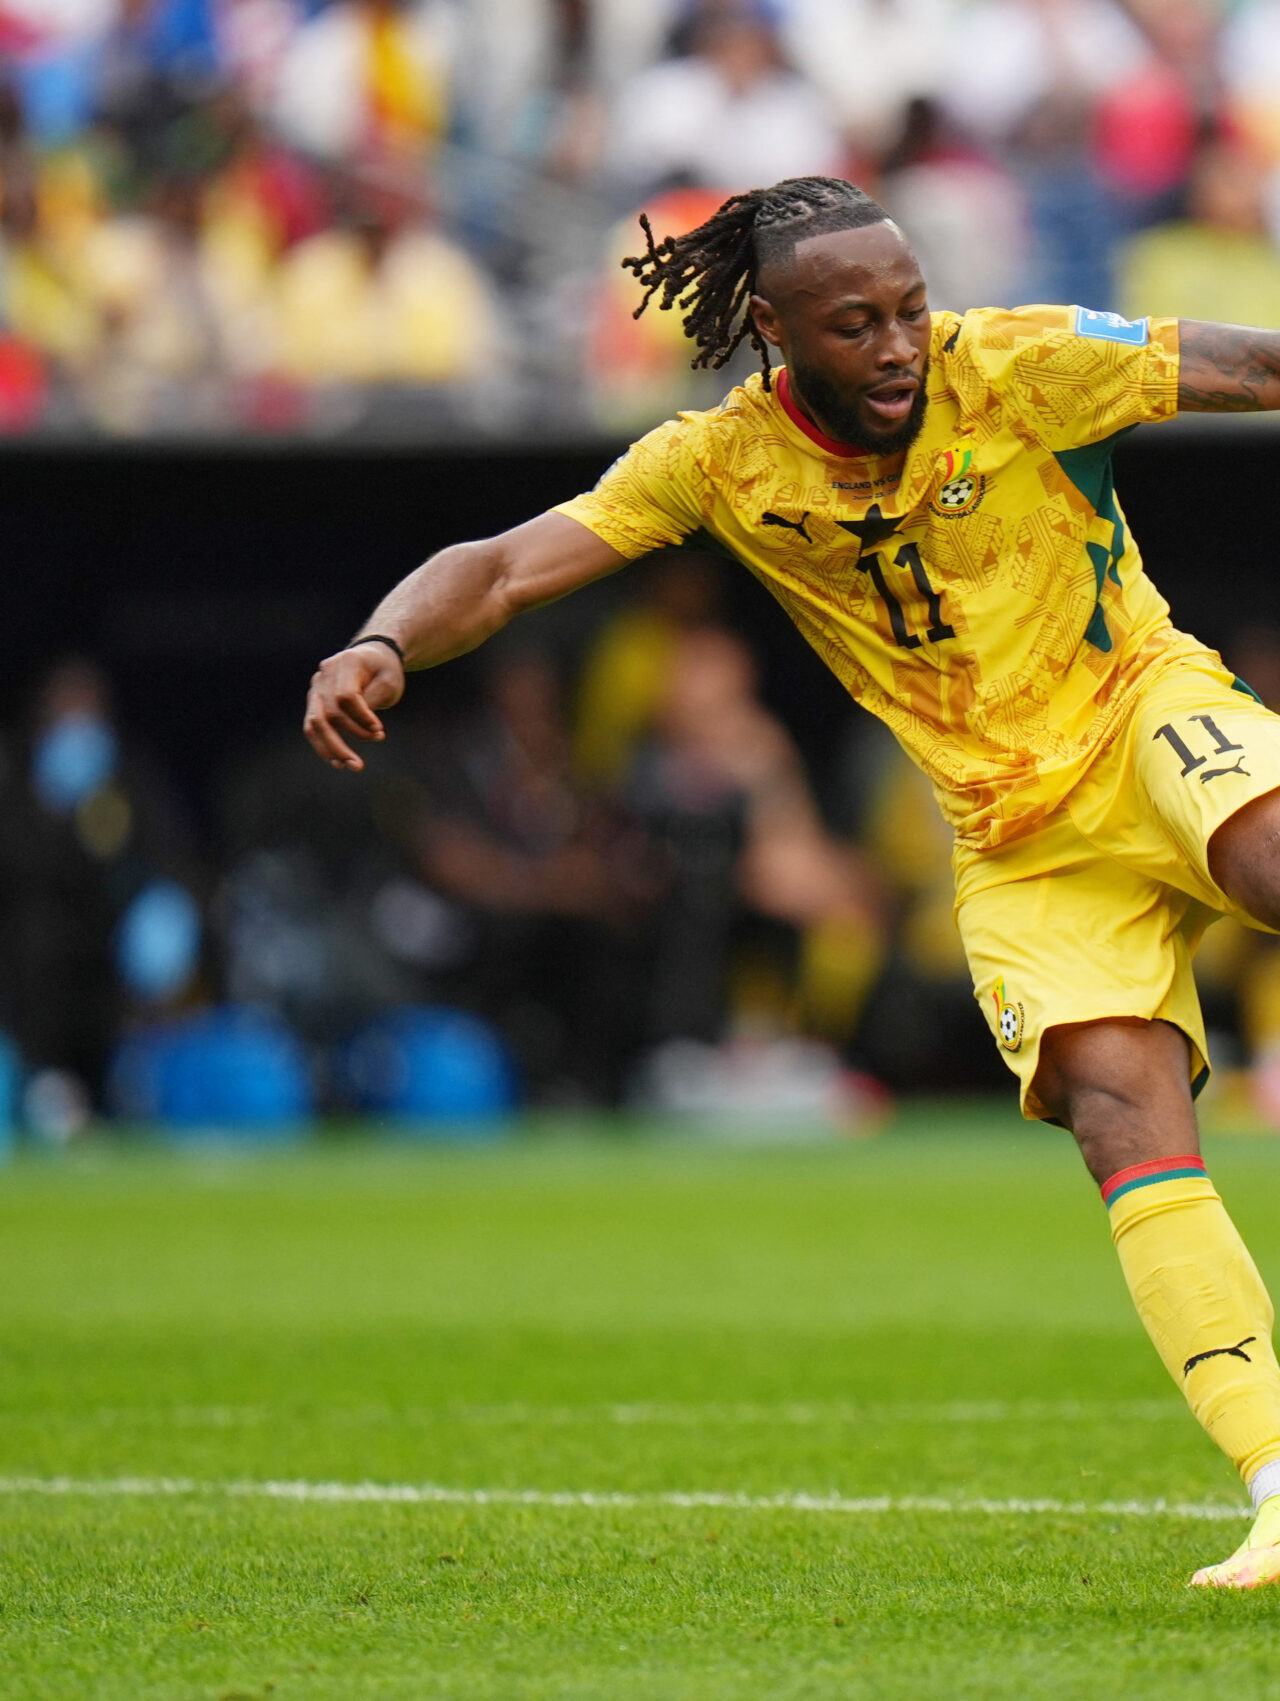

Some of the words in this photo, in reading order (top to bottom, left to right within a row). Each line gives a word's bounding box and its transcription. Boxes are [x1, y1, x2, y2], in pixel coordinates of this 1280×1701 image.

[832, 481, 872, 490] ENGLAND
[873, 478, 886, 487] VS
[855, 542, 956, 649] 11
[1152, 714, 1244, 778] 11
